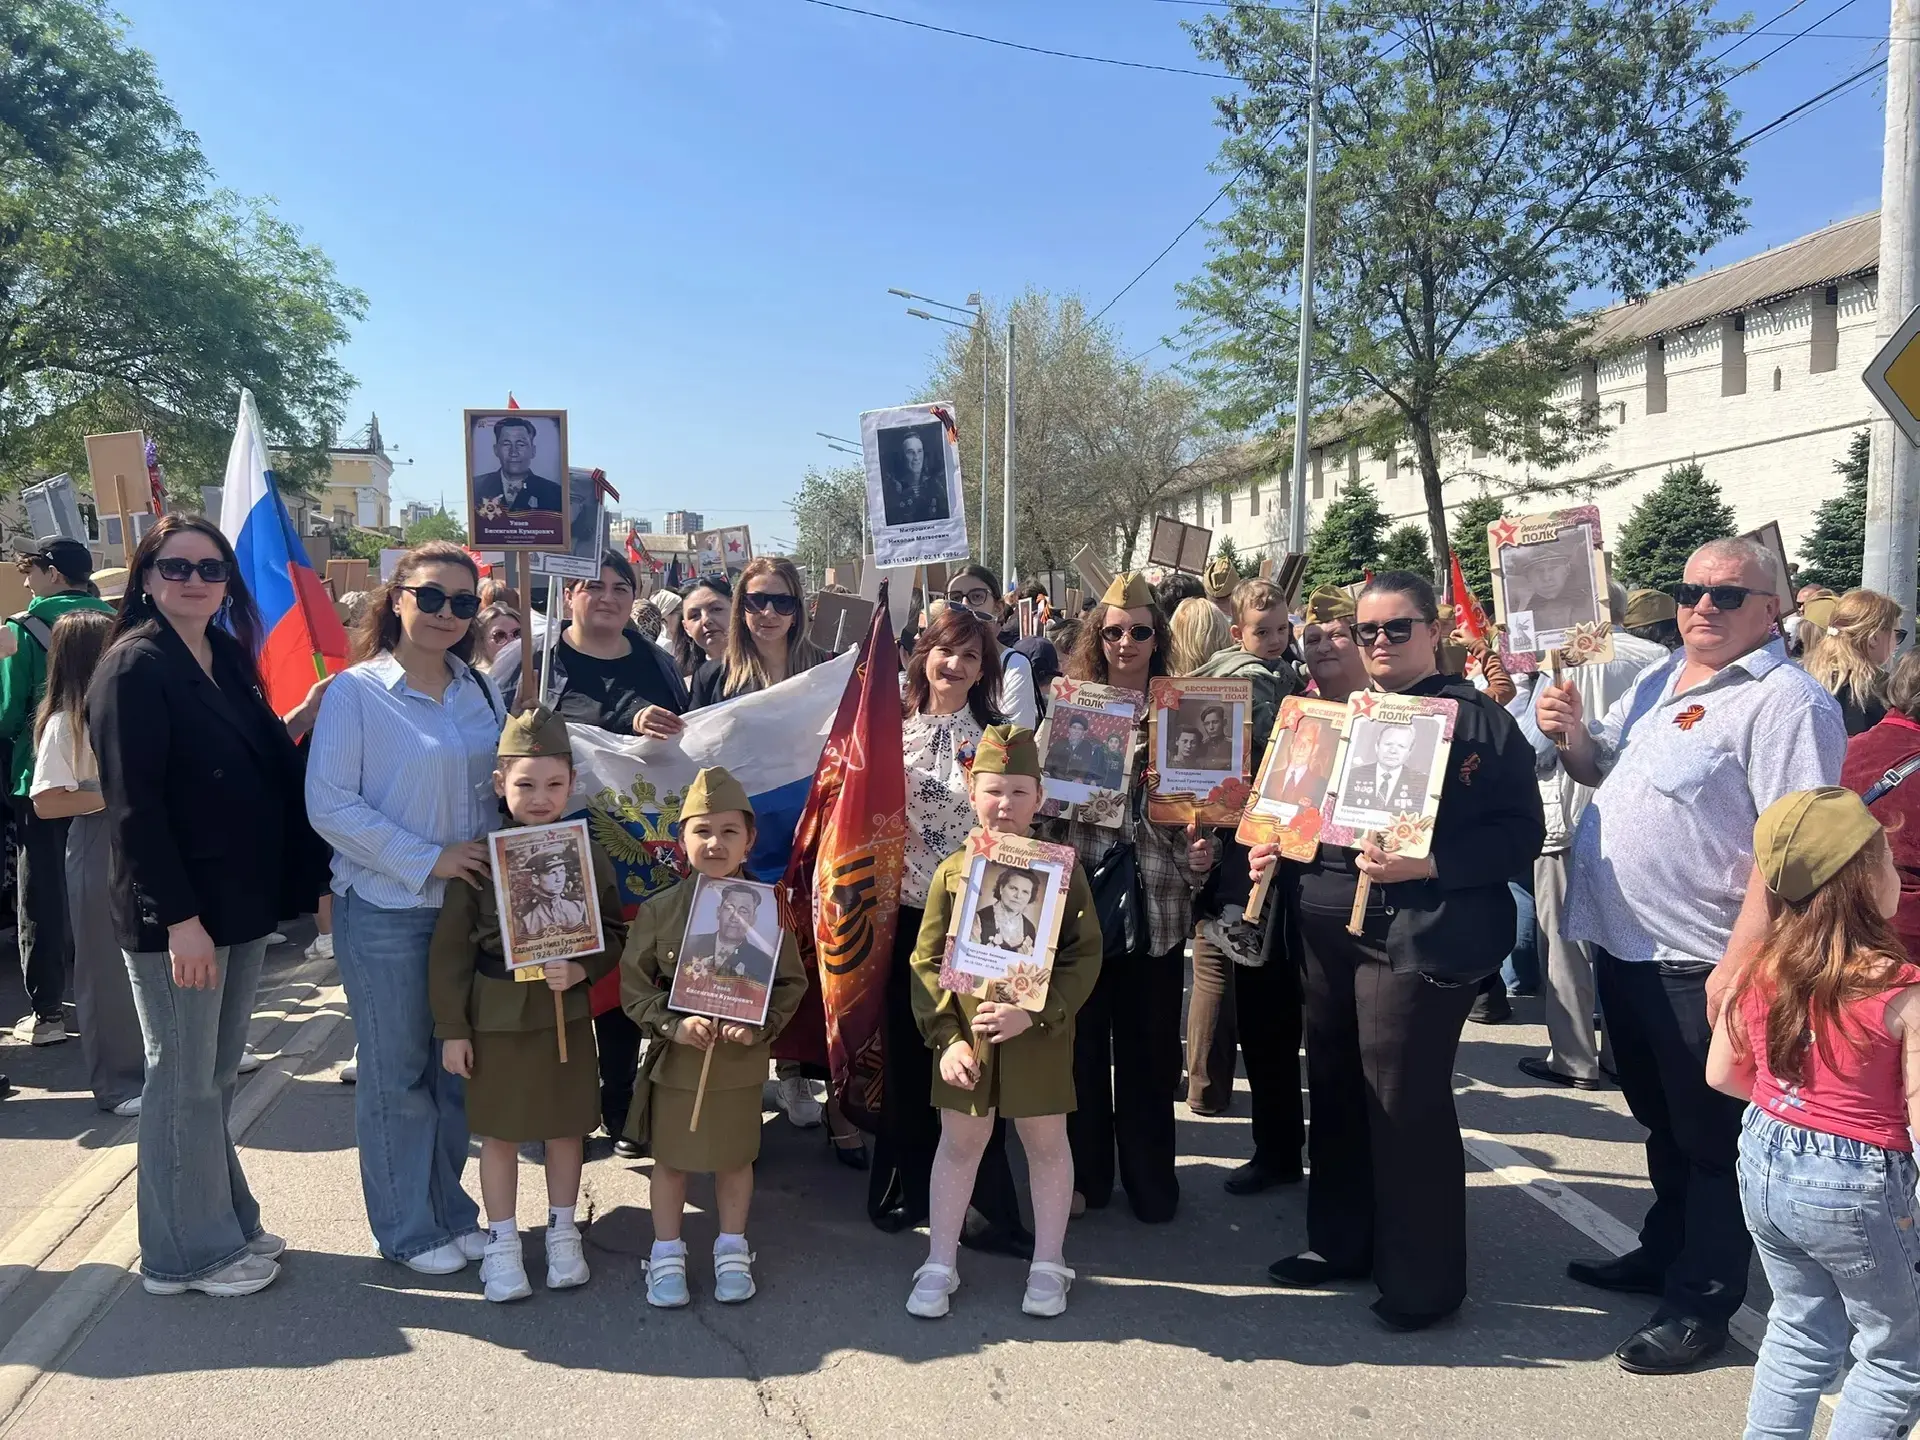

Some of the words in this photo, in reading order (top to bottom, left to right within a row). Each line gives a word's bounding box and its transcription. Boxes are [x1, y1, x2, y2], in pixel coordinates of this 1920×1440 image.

[916, 533, 949, 541] Матвеевич
[1522, 530, 1556, 543] ПОЛК
[1185, 685, 1248, 693] БЕССМЕРТНЫЙ
[1077, 698, 1104, 709] ПОЛК
[1378, 711, 1411, 722] ПОЛК
[997, 853, 1029, 867] ПОЛК
[532, 947, 573, 960] 1924-1999
